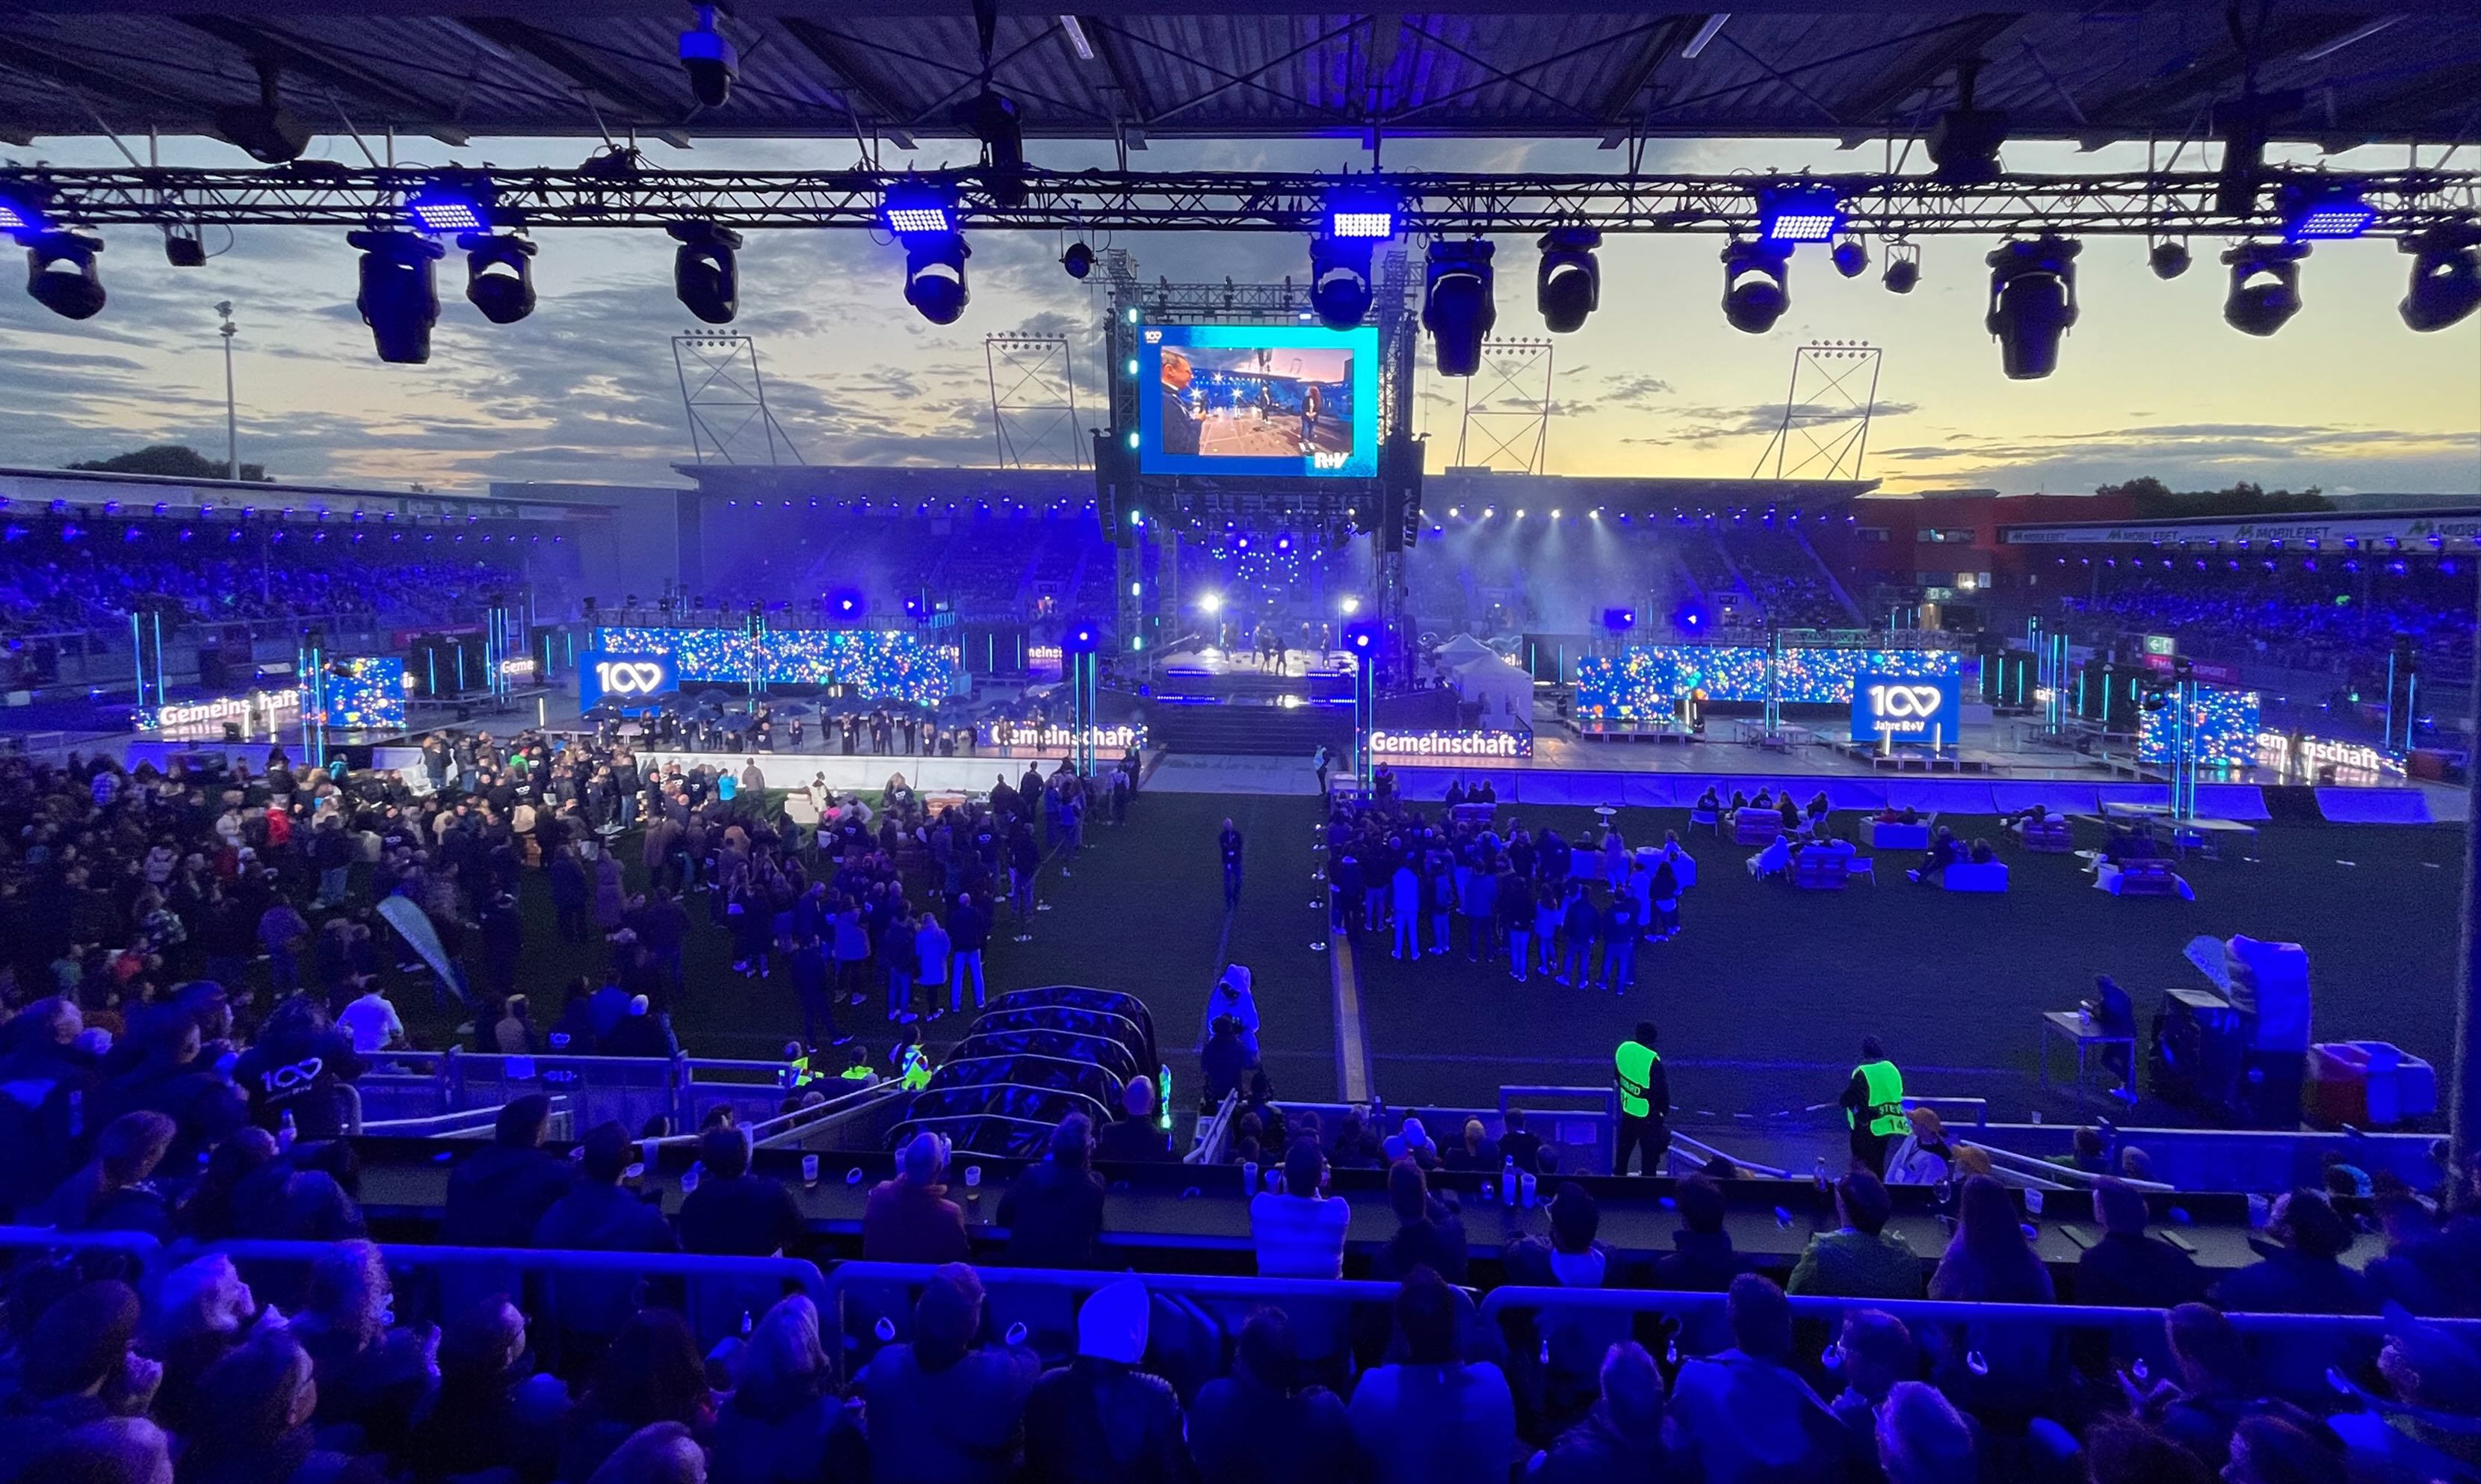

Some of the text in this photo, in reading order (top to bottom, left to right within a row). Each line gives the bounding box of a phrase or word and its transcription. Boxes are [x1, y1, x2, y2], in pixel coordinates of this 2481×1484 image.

[1314, 451, 1350, 469] R+V
[2122, 531, 2178, 542] MOBILEBET
[2255, 526, 2331, 539] MOBILEBET
[159, 689, 300, 725] Gemeinshaft
[1874, 720, 1925, 732] Jahre R+V
[1371, 731, 1518, 755] Gemeinschaft
